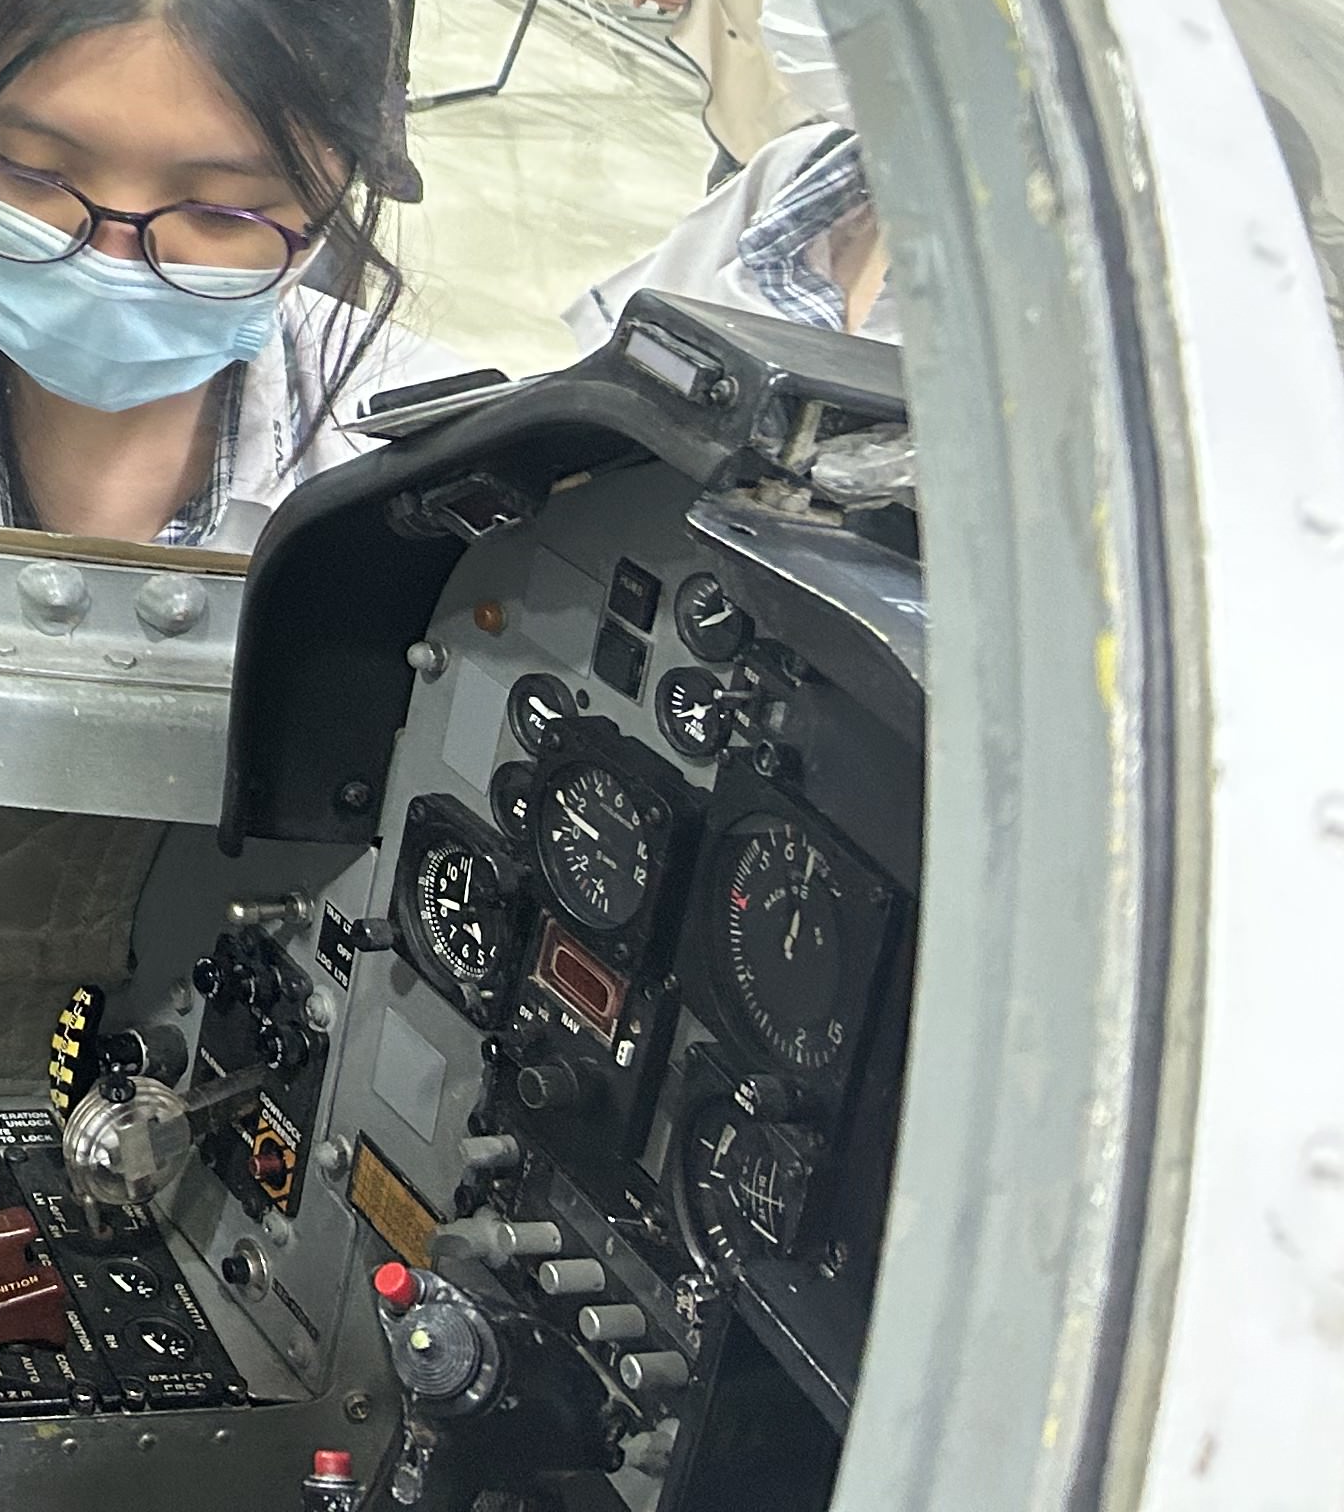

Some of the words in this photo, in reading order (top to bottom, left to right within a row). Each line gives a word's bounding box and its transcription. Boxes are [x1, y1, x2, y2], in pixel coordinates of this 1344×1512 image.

[684, 722, 706, 743] TRIM
[595, 782, 604, 797] 4
[577, 798, 587, 814] 2
[615, 792, 624, 808] 6
[572, 825, 580, 840] 0
[446, 862, 458, 882] 10
[633, 865, 647, 886] 12
[439, 877, 447, 892] 9
[449, 924, 458, 940] 7
[336, 943, 352, 962] OFF
[462, 944, 470, 958] 6
[477, 949, 485, 966] 5
[334, 967, 349, 987] LTS
[519, 1005, 533, 1021] OFF
[561, 1012, 580, 1034] NAV
[6, 1119, 53, 1128] UNLOCK
[260, 1091, 283, 1121] DOWN
[281, 1117, 303, 1143] LOCK
[0, 1136, 16, 1144] TO
[22, 1134, 53, 1143] LOCK
[261, 1110, 297, 1152] OVERRIDE
[38, 1253, 52, 1267] EC
[73, 1274, 88, 1289] LH
[174, 1283, 208, 1332] QUANTITY
[66, 1310, 93, 1353] IGNITION
[104, 1334, 119, 1349] RH
[20, 1355, 41, 1384] AUTO
[55, 1353, 76, 1381] CONT
